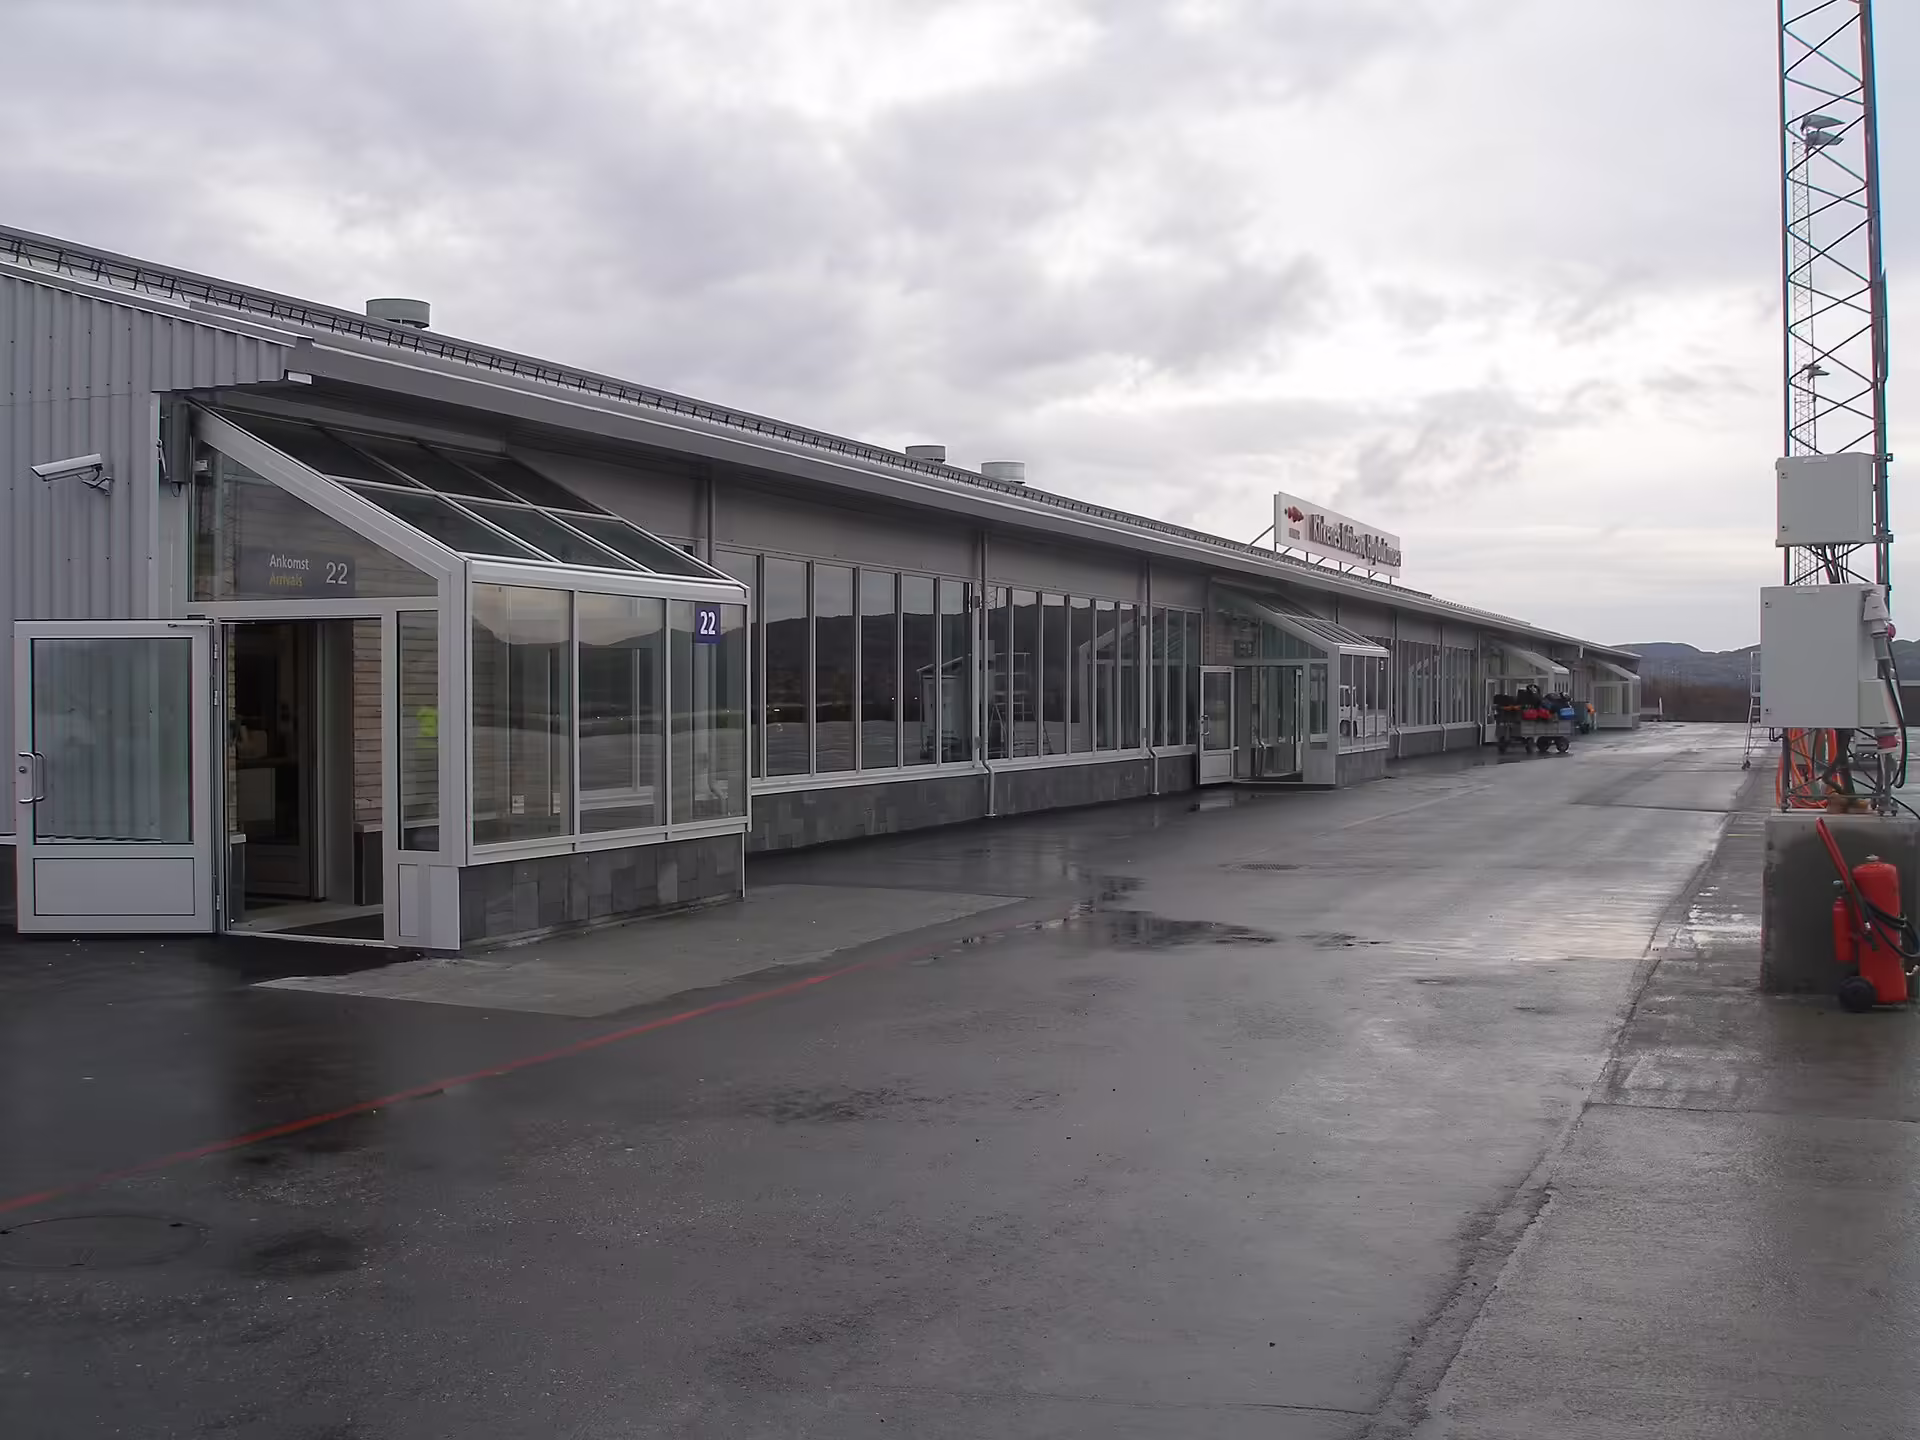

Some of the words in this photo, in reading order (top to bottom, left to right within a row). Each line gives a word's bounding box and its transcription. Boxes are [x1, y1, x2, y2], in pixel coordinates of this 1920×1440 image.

[269, 553, 310, 570] Ankomst
[325, 561, 348, 585] 22
[700, 611, 716, 635] 22
